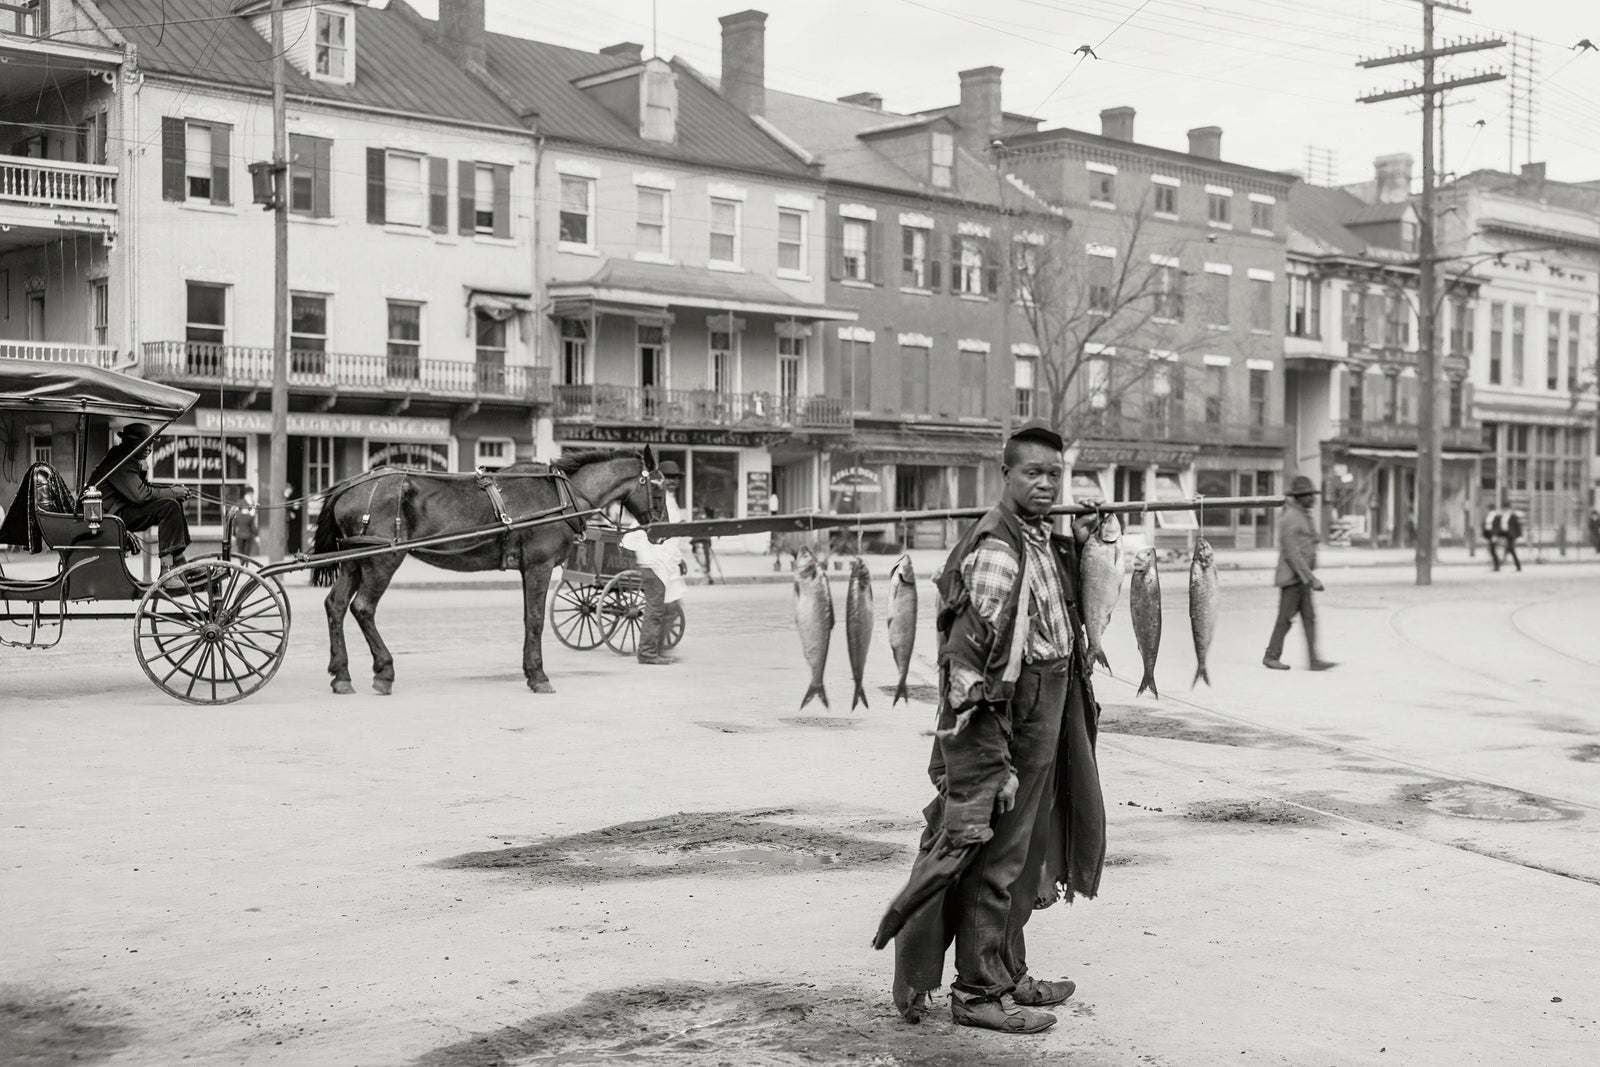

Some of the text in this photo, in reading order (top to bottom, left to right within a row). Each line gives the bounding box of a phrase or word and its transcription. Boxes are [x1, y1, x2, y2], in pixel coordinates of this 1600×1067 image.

[205, 414, 266, 428] POSTAL
[286, 415, 362, 432] ELEGRAPH
[368, 419, 415, 433] CABLE
[592, 429, 621, 440] GAS
[153, 438, 188, 464] POSTAL
[178, 456, 222, 471] OFFICE
